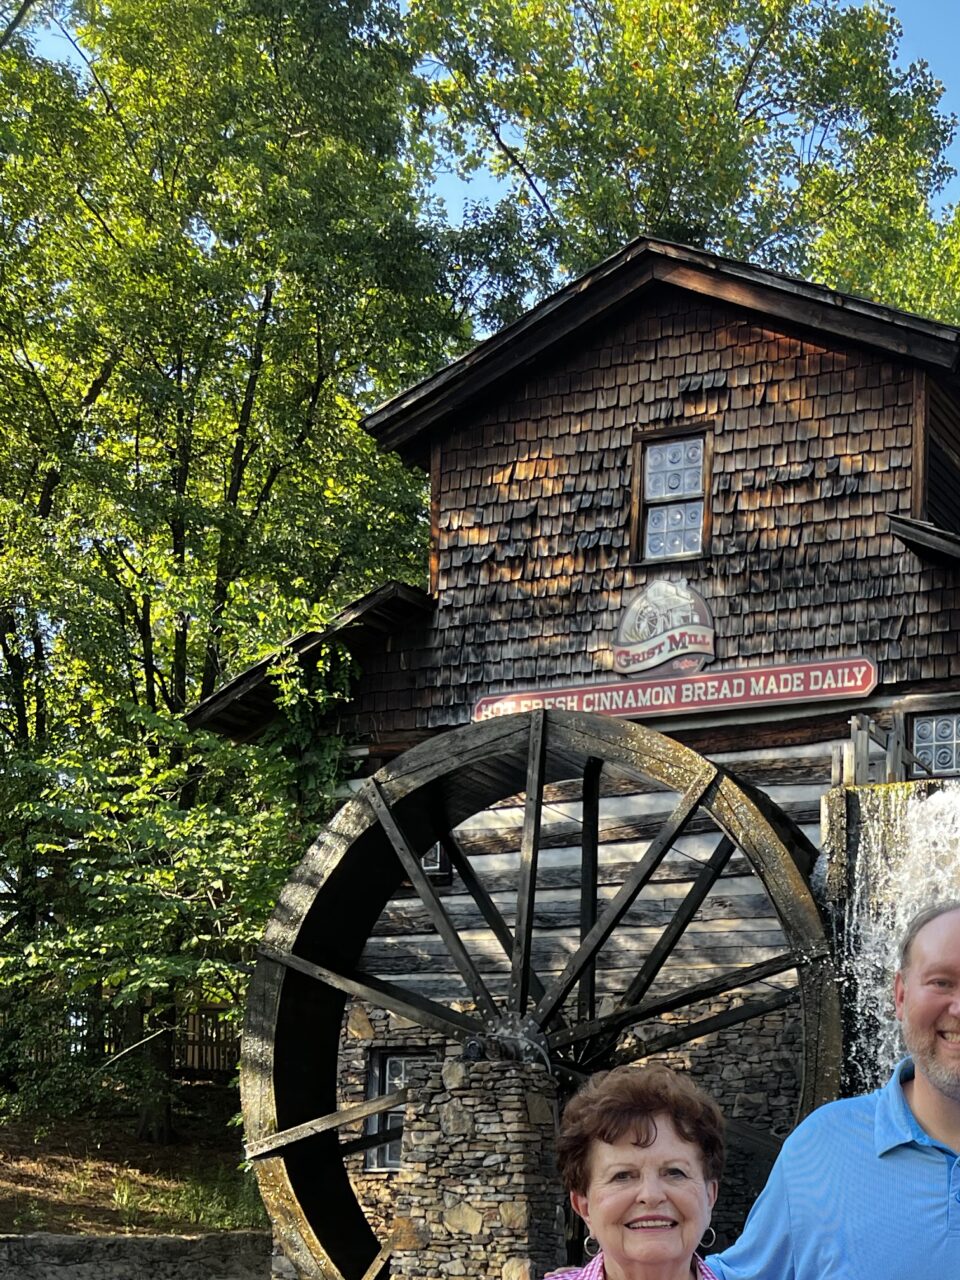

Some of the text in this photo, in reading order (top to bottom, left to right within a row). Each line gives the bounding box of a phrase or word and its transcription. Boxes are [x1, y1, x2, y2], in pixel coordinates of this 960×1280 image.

[583, 685, 677, 711] CINNAMON
[681, 678, 745, 703] BREAD
[750, 672, 804, 695] MADE
[809, 666, 867, 690] DAILY
